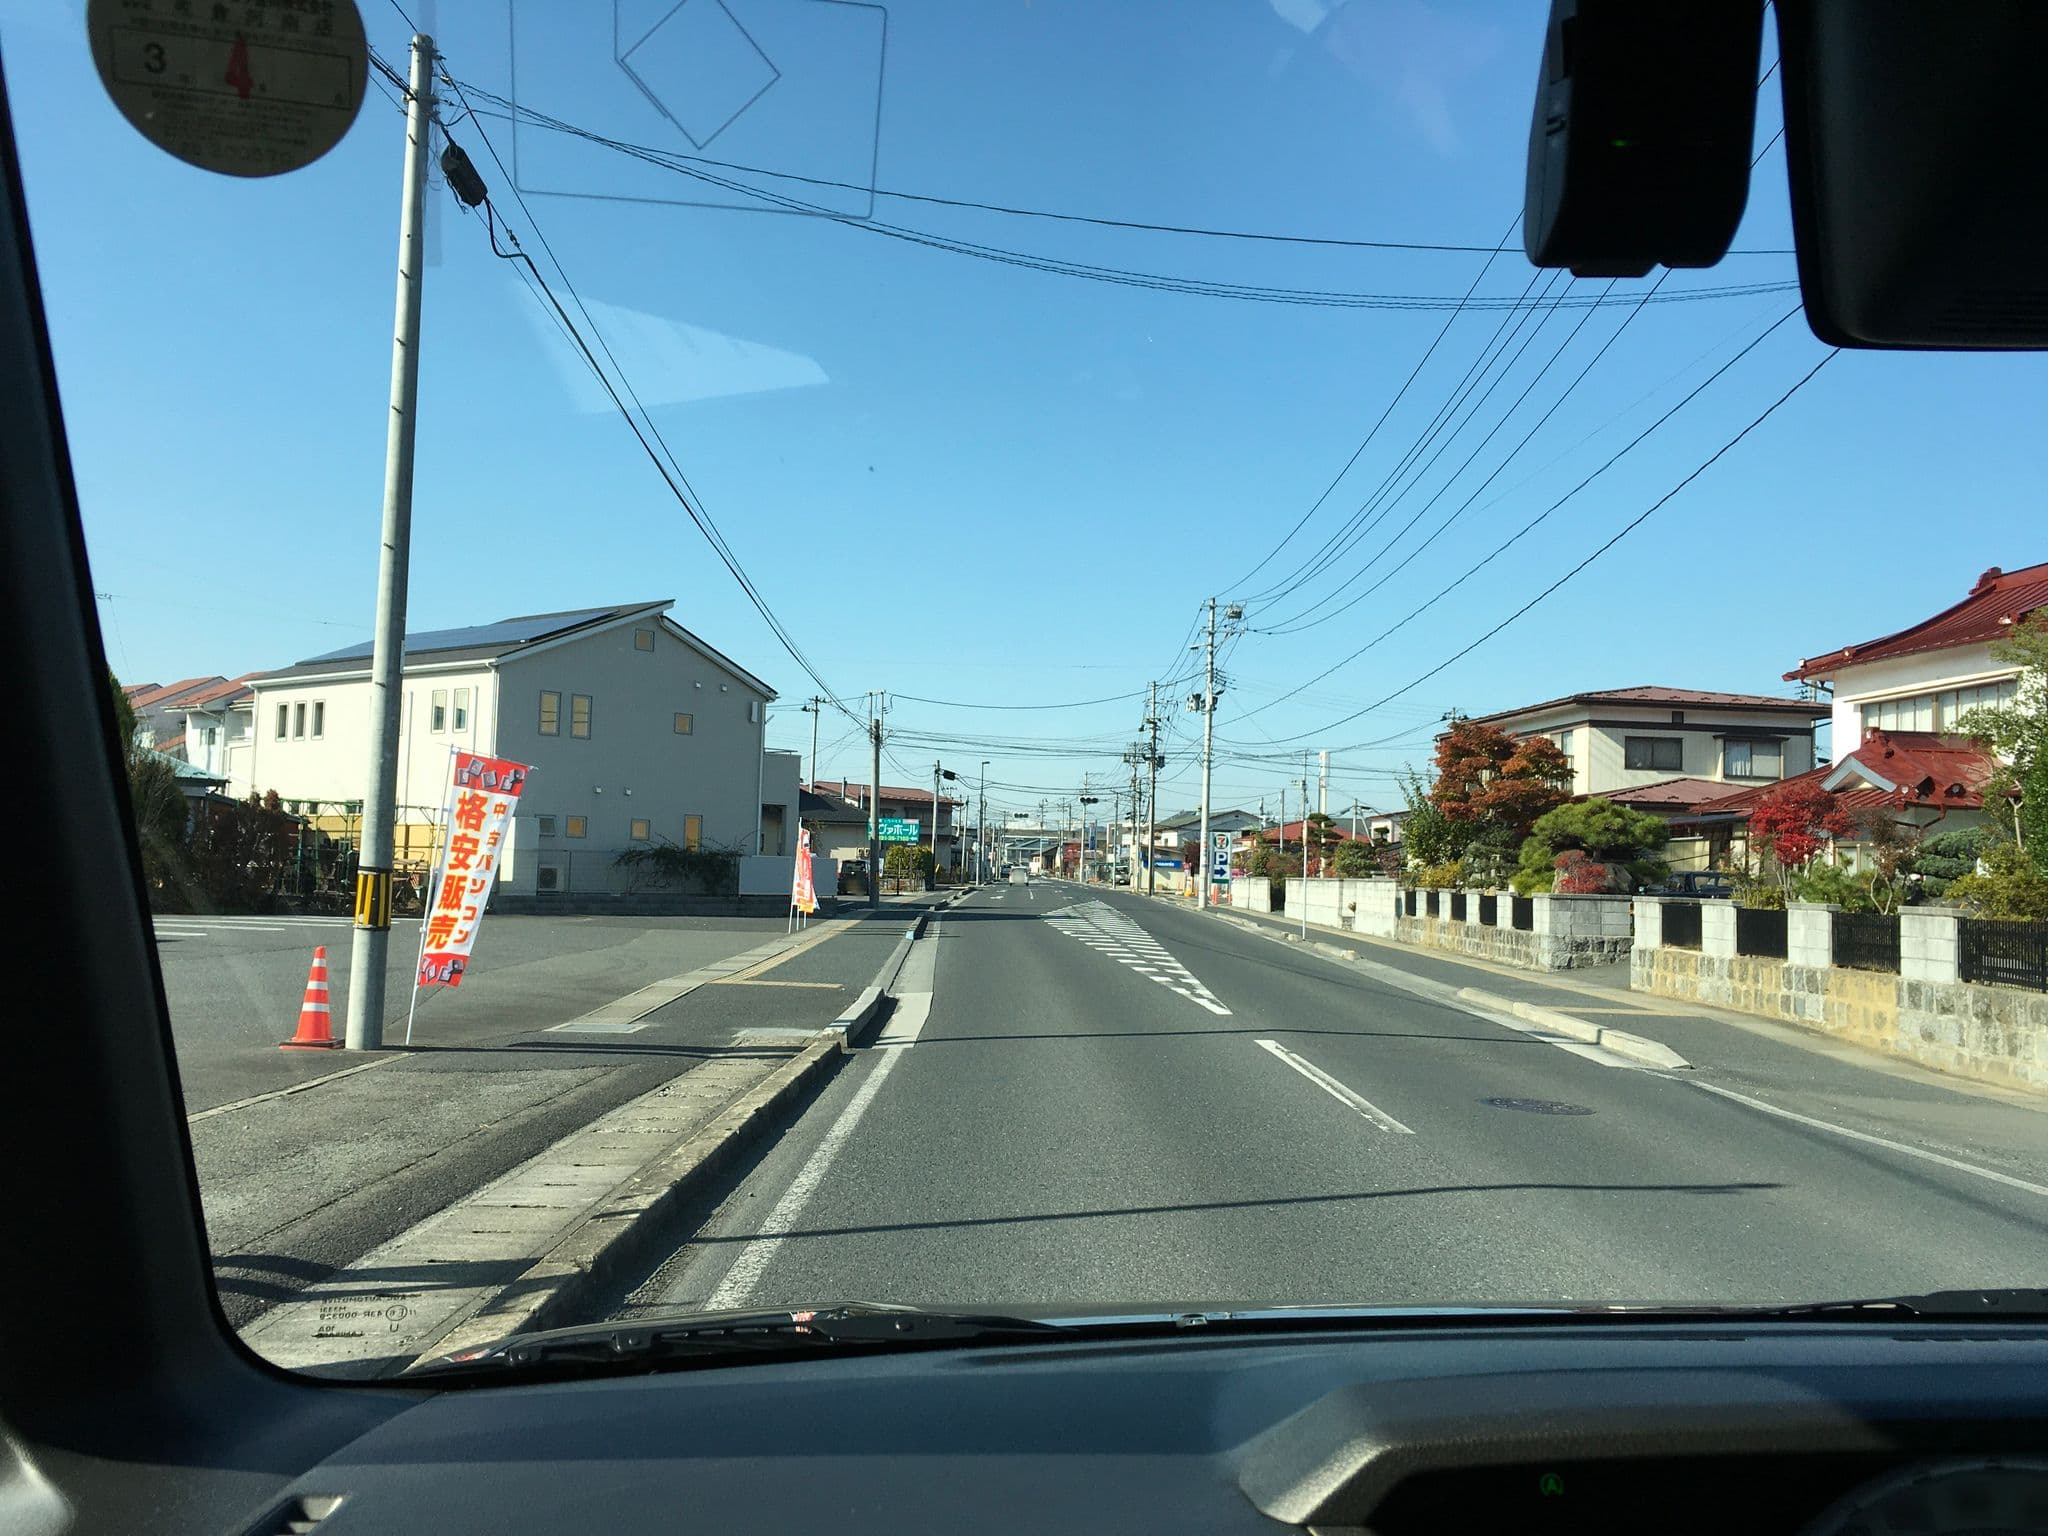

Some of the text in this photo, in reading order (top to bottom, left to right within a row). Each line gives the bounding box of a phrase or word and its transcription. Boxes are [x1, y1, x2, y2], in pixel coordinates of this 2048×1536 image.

[144, 42, 166, 75] 3
[868, 823, 918, 835] ヴァホール
[426, 791, 489, 950] 格安販売
[453, 801, 508, 945] 中古パソコン
[1216, 851, 1227, 865] P
